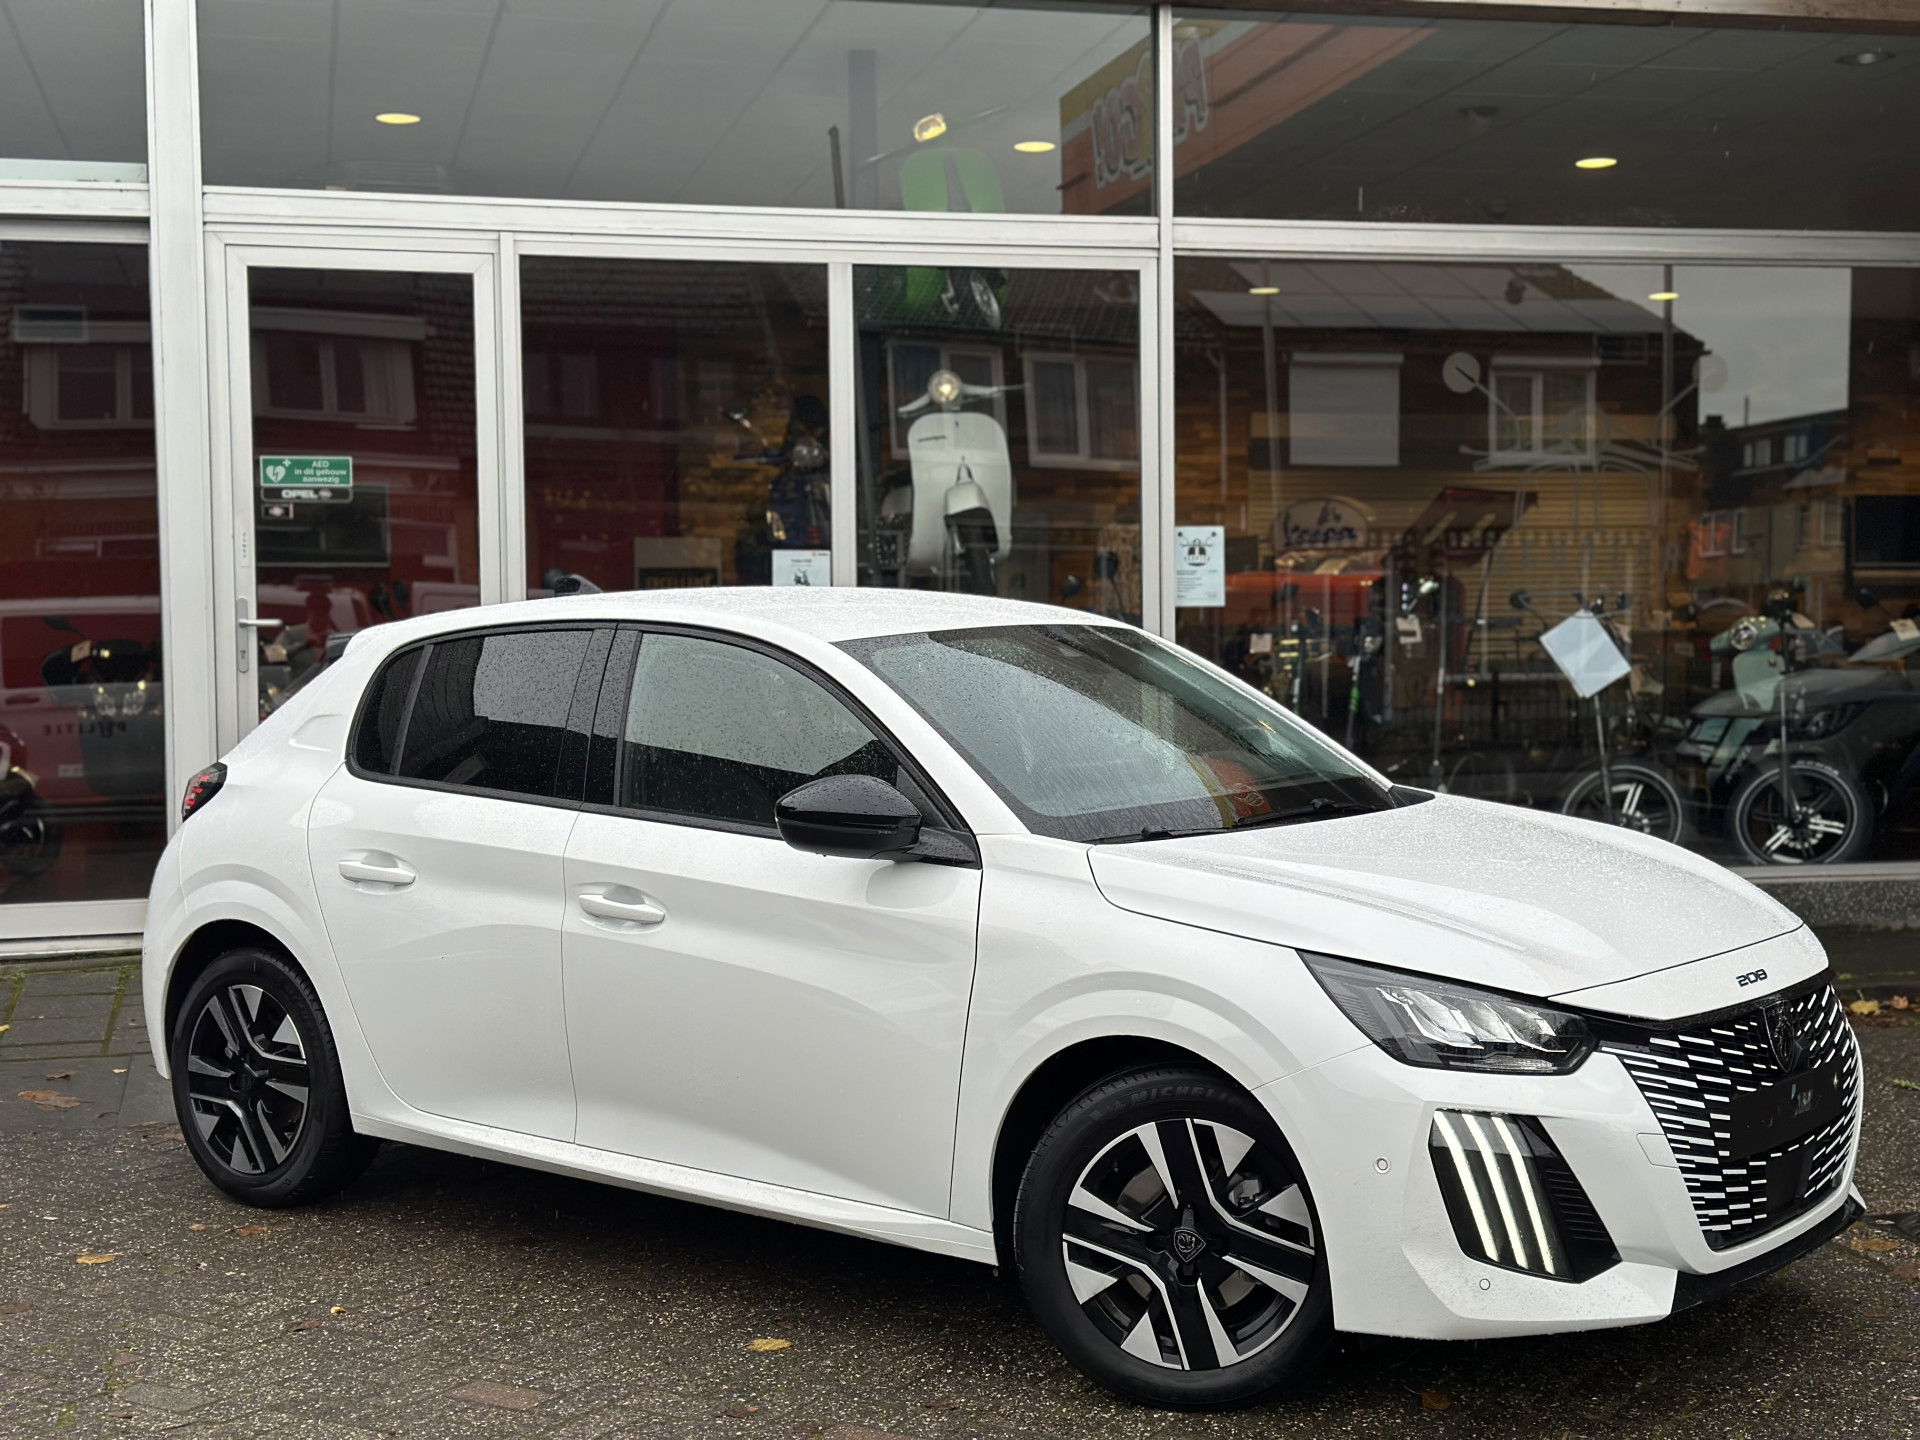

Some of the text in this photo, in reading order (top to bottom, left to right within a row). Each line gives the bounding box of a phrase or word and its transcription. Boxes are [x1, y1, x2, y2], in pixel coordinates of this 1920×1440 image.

[315, 468, 347, 478] gebouw
[302, 476, 340, 484] aanwezig
[281, 490, 318, 499] OPEL
[1735, 968, 1768, 988] 208
